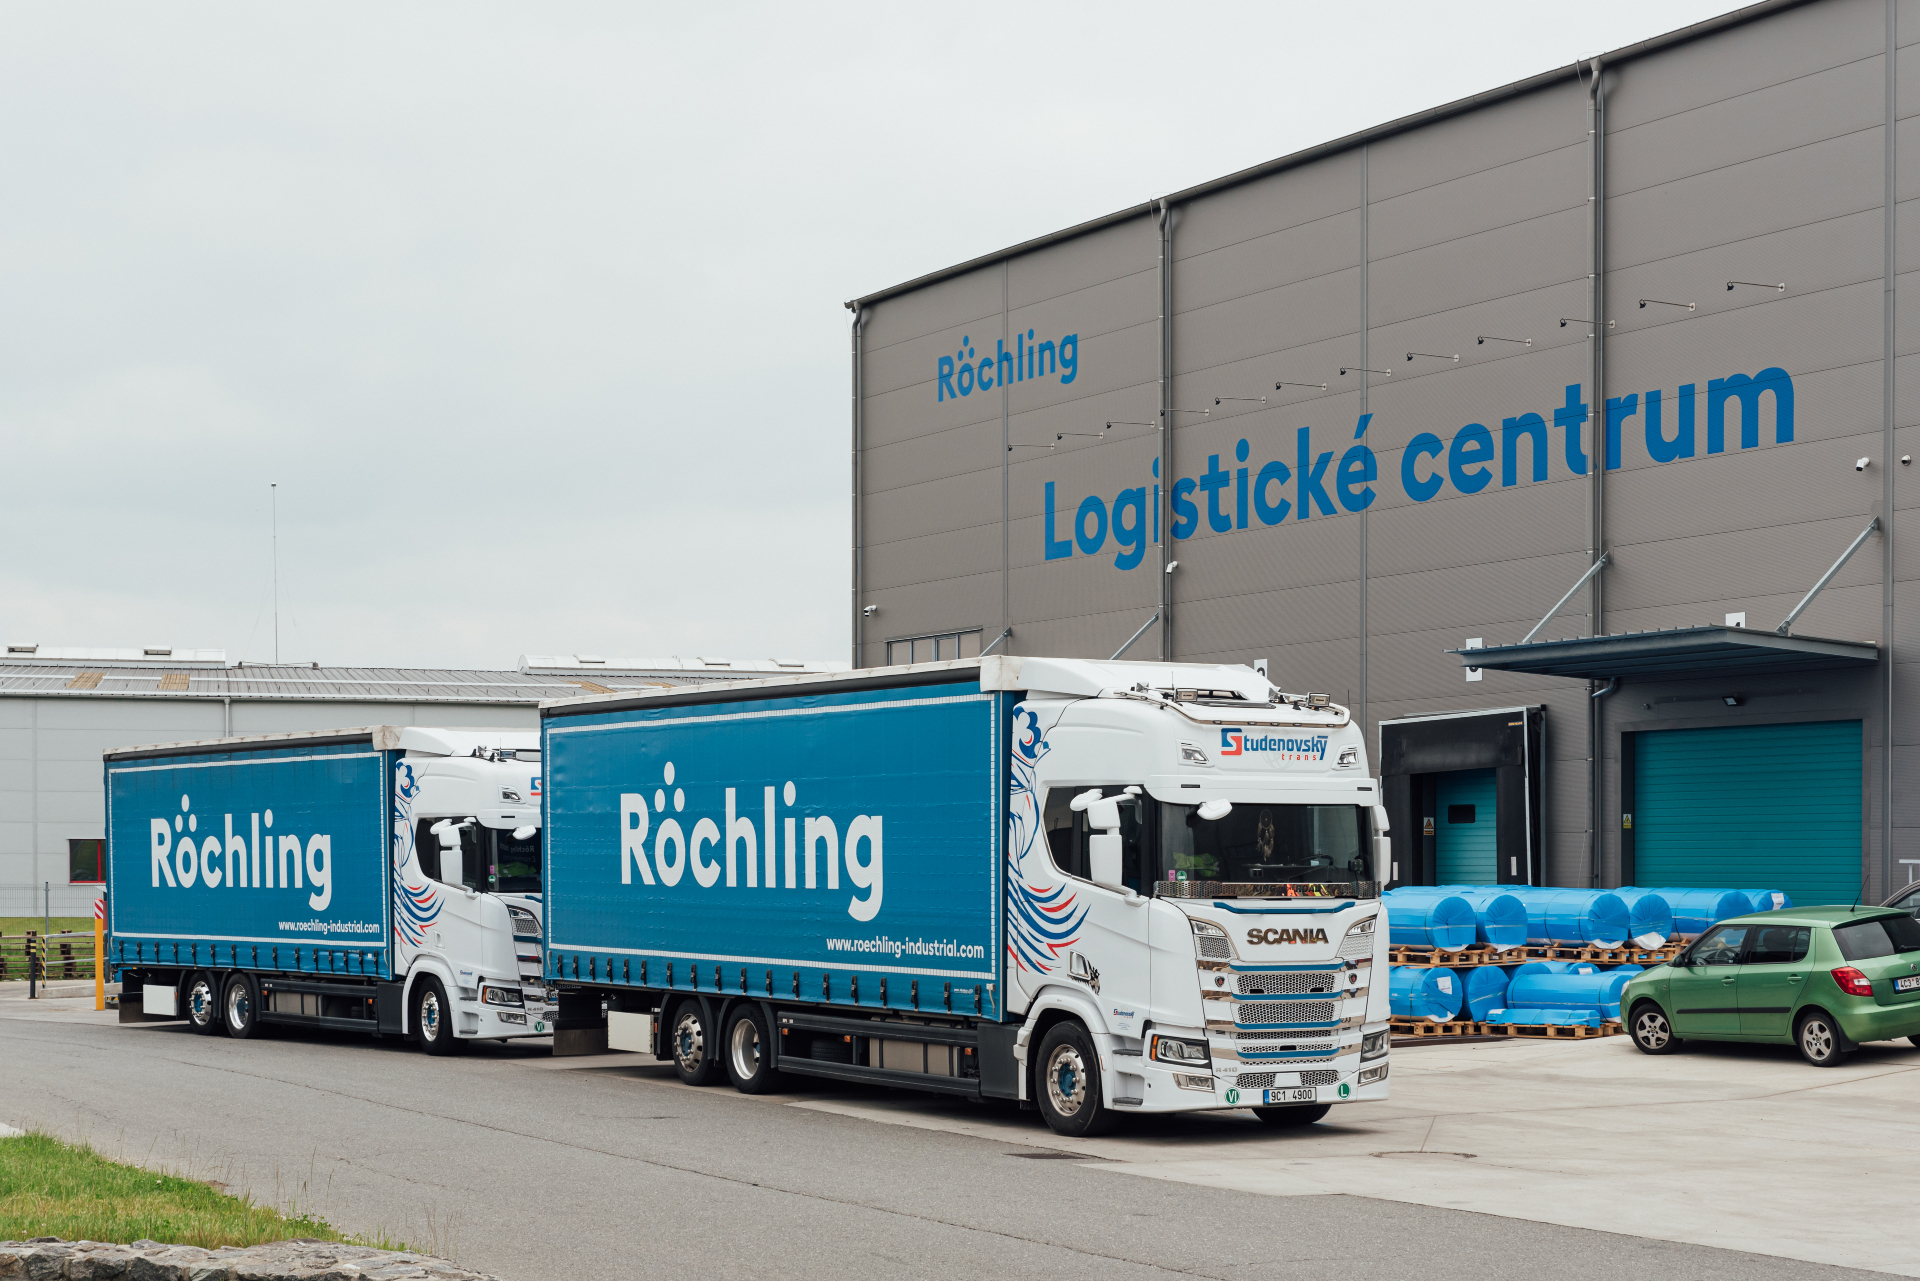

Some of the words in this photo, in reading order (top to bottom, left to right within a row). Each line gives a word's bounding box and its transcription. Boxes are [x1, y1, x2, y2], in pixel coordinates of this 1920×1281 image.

[938, 329, 1078, 402] Röchling
[1401, 366, 1795, 502] centrum
[1281, 752, 1317, 761] trans
[621, 761, 884, 921] Röchling
[150, 794, 332, 912] Röchling
[278, 918, 380, 935] www.roechling-industrial.com
[1246, 928, 1329, 945] SCANIA
[826, 934, 985, 959] www.roechling-industrial.com
[1271, 1090, 1286, 1102] 9C1
[1292, 1089, 1313, 1101] 4900
[1341, 1085, 1348, 1096] L
